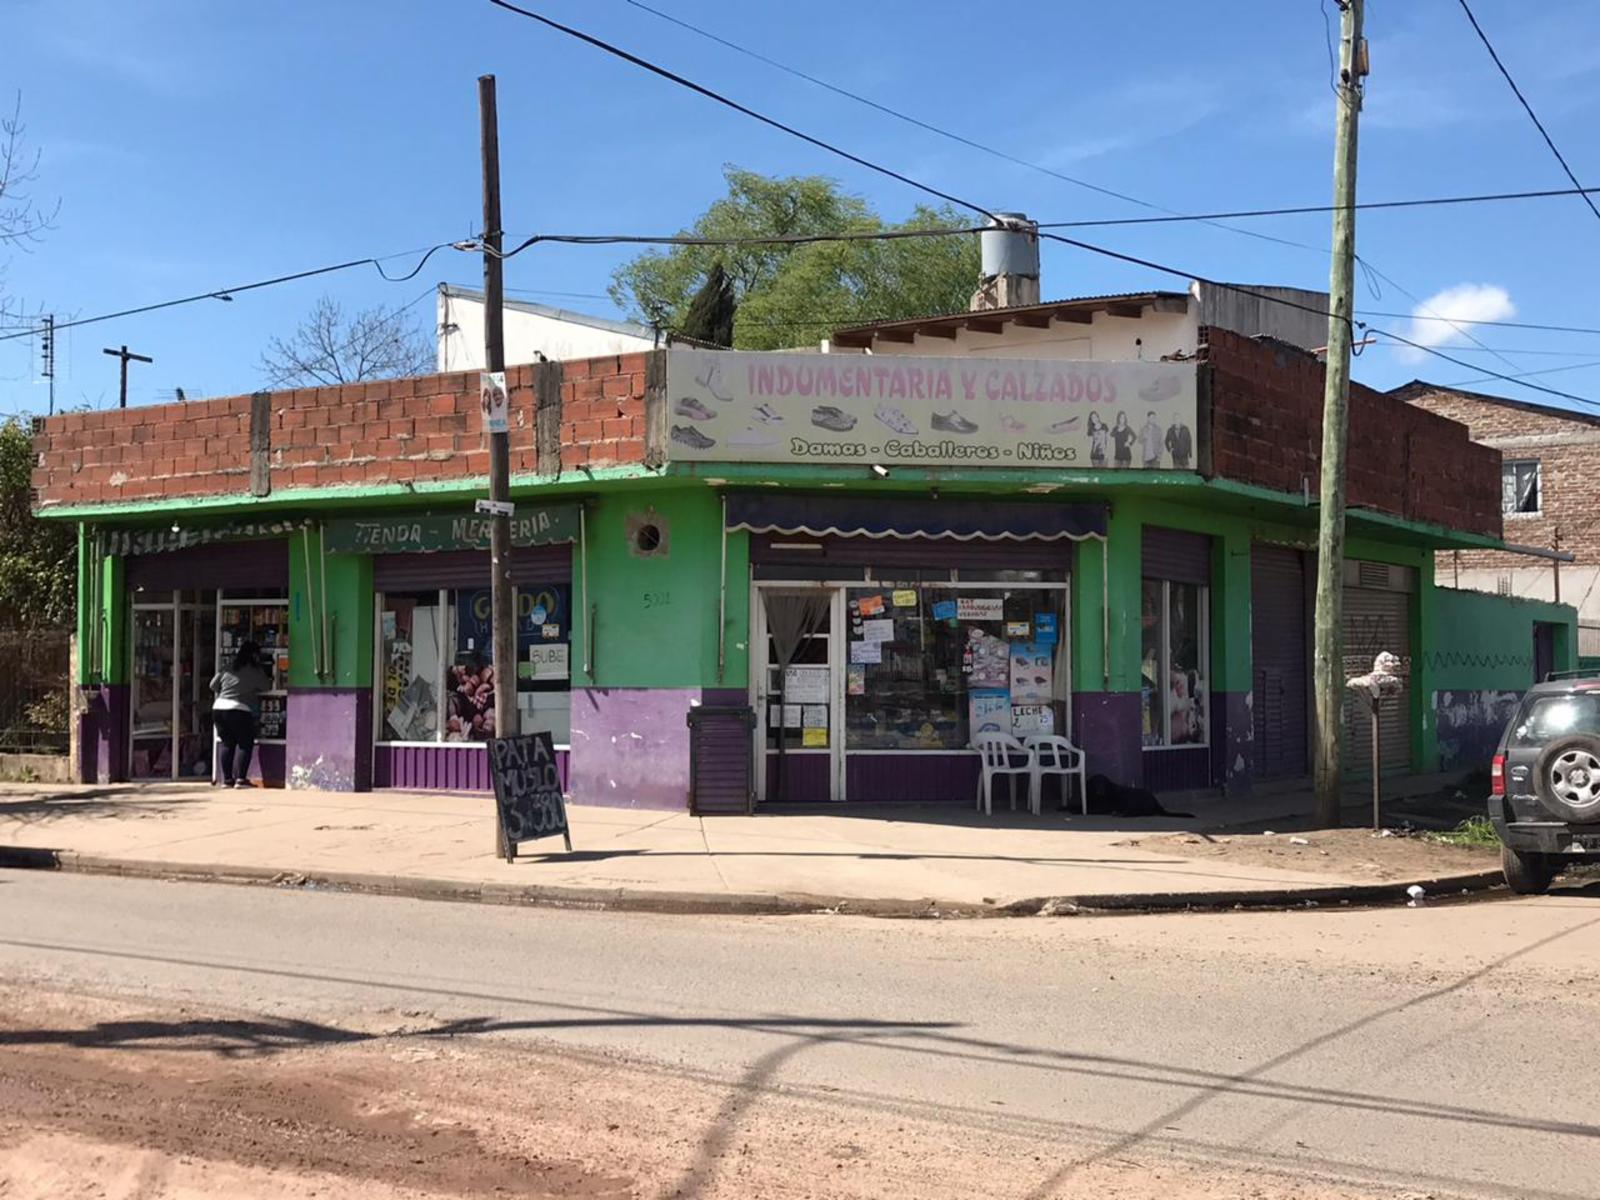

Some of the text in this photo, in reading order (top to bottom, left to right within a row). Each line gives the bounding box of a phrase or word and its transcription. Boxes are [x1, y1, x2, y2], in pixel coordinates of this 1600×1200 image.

[748, 364, 1117, 403] INDUMENTARIA Y CALZADOS
[791, 437, 866, 457] Damas
[884, 439, 998, 459] Caballeros
[1017, 442, 1077, 460] Niños
[355, 522, 421, 544] TIENDA
[452, 511, 549, 542] MERERIA
[474, 591, 556, 620] GDO
[532, 649, 564, 663] SUBE
[495, 736, 551, 769] PATA
